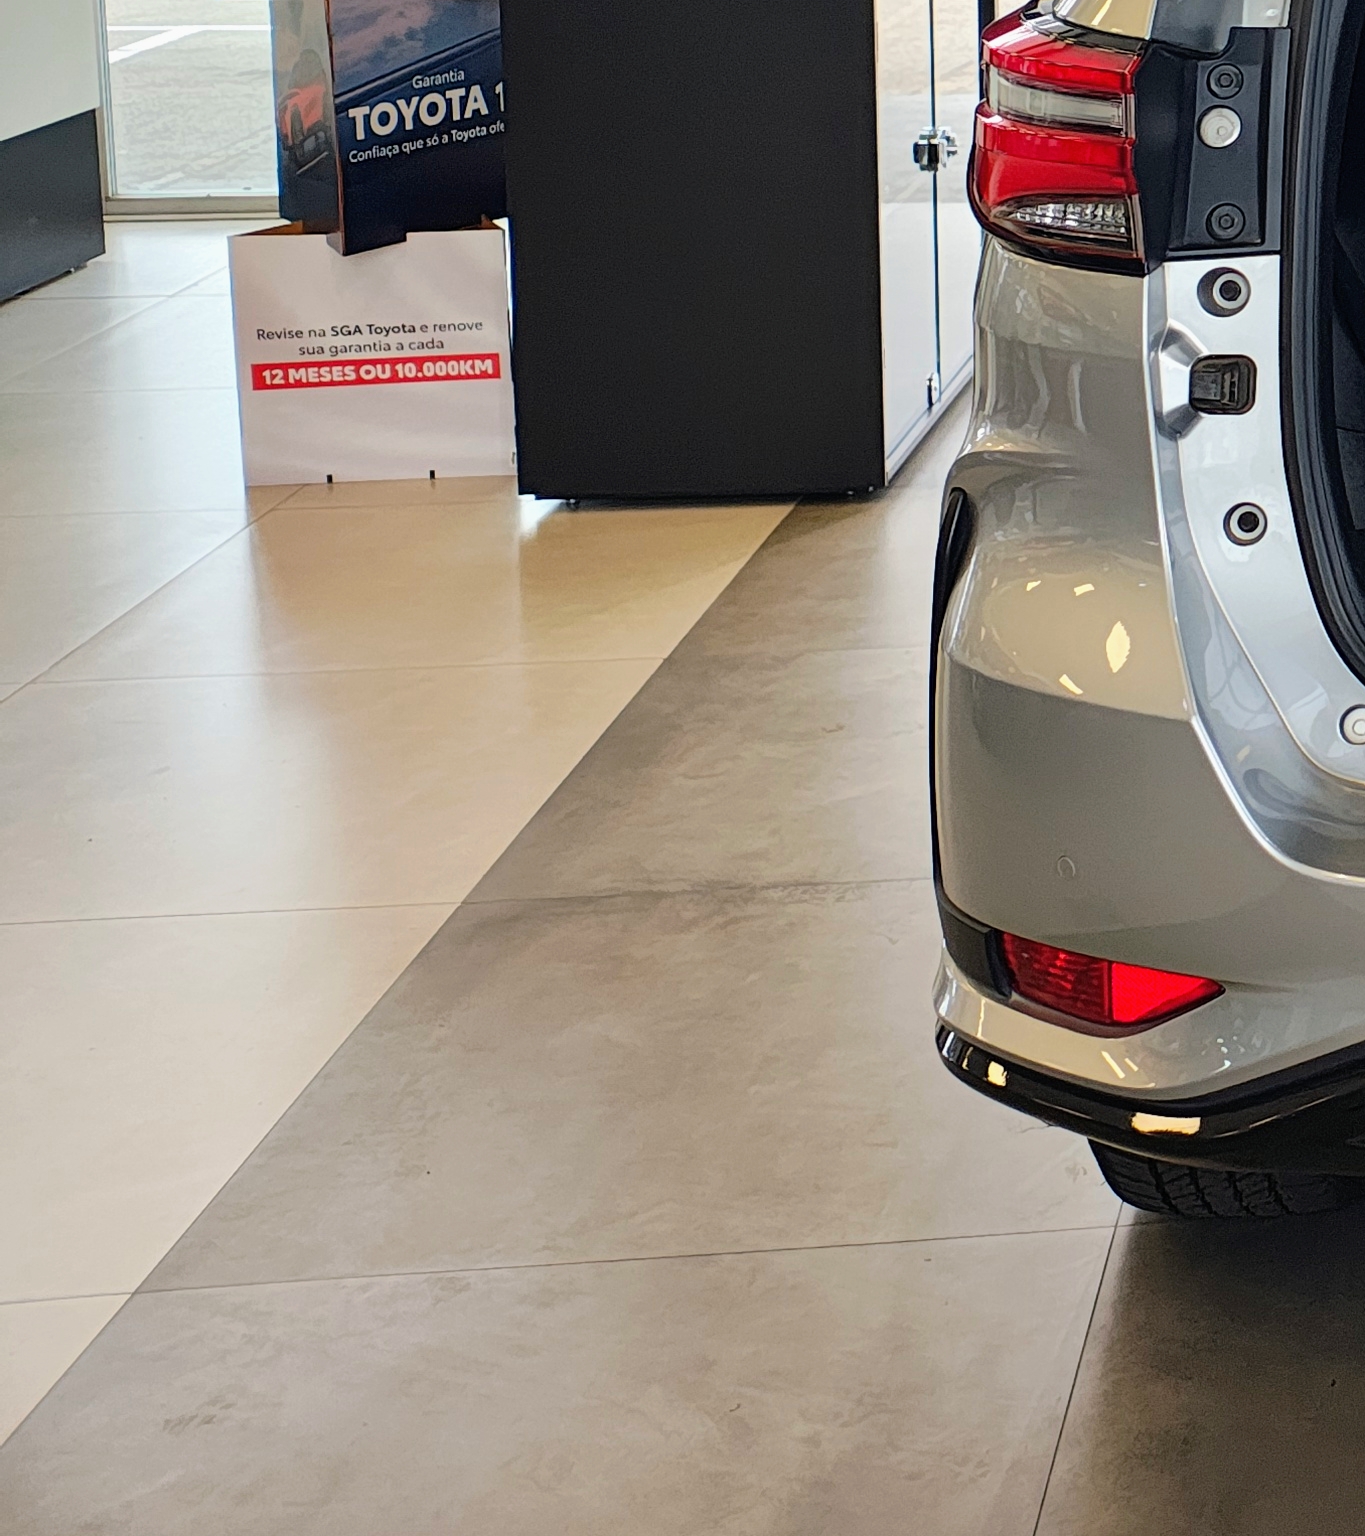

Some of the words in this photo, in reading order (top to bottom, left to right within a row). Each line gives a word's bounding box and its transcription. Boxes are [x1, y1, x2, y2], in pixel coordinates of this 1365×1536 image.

[412, 68, 465, 89] Garantia
[348, 84, 489, 141] TOYOTA
[349, 143, 400, 163] Confiaça
[402, 138, 424, 154] que
[426, 133, 440, 146] só
[441, 135, 449, 144] a
[450, 125, 487, 143] Toyota
[256, 327, 304, 341] Revise
[308, 327, 327, 338] na
[330, 325, 363, 337] SGA
[366, 323, 416, 339] Toyota
[419, 324, 429, 333] e
[433, 321, 484, 333] renove
[298, 344, 325, 356] sua
[329, 339, 392, 357] garantia
[395, 341, 405, 351] a
[408, 337, 445, 351] cada
[262, 369, 286, 385] 12
[288, 365, 356, 384] MESES
[359, 363, 392, 381] OU
[395, 358, 494, 379] 10.000KM
